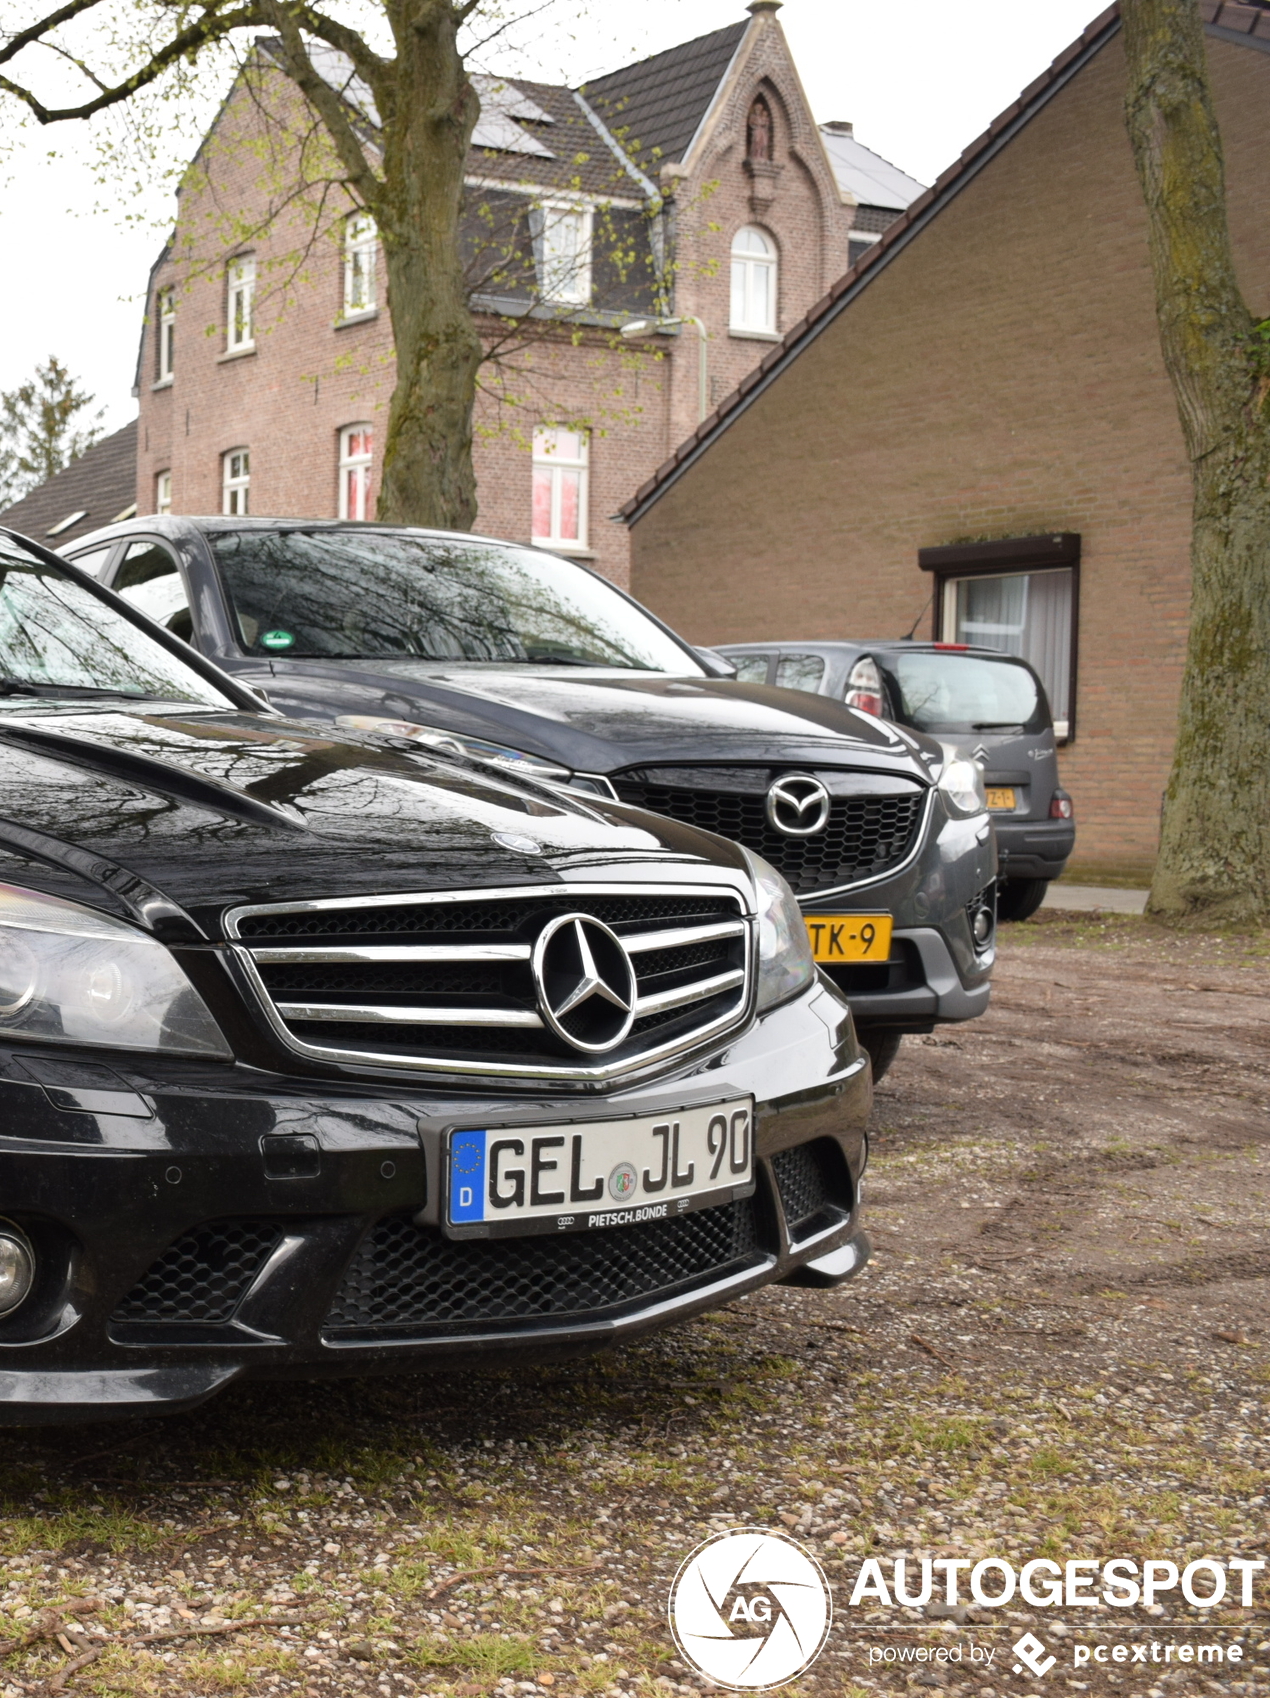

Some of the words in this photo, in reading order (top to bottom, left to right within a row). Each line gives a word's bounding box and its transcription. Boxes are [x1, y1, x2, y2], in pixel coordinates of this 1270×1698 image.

[805, 923, 876, 955] TK-9
[488, 1133, 605, 1209] GEL
[642, 1121, 695, 1193] JL
[707, 1108, 749, 1180] 90
[459, 1187, 472, 1207] D
